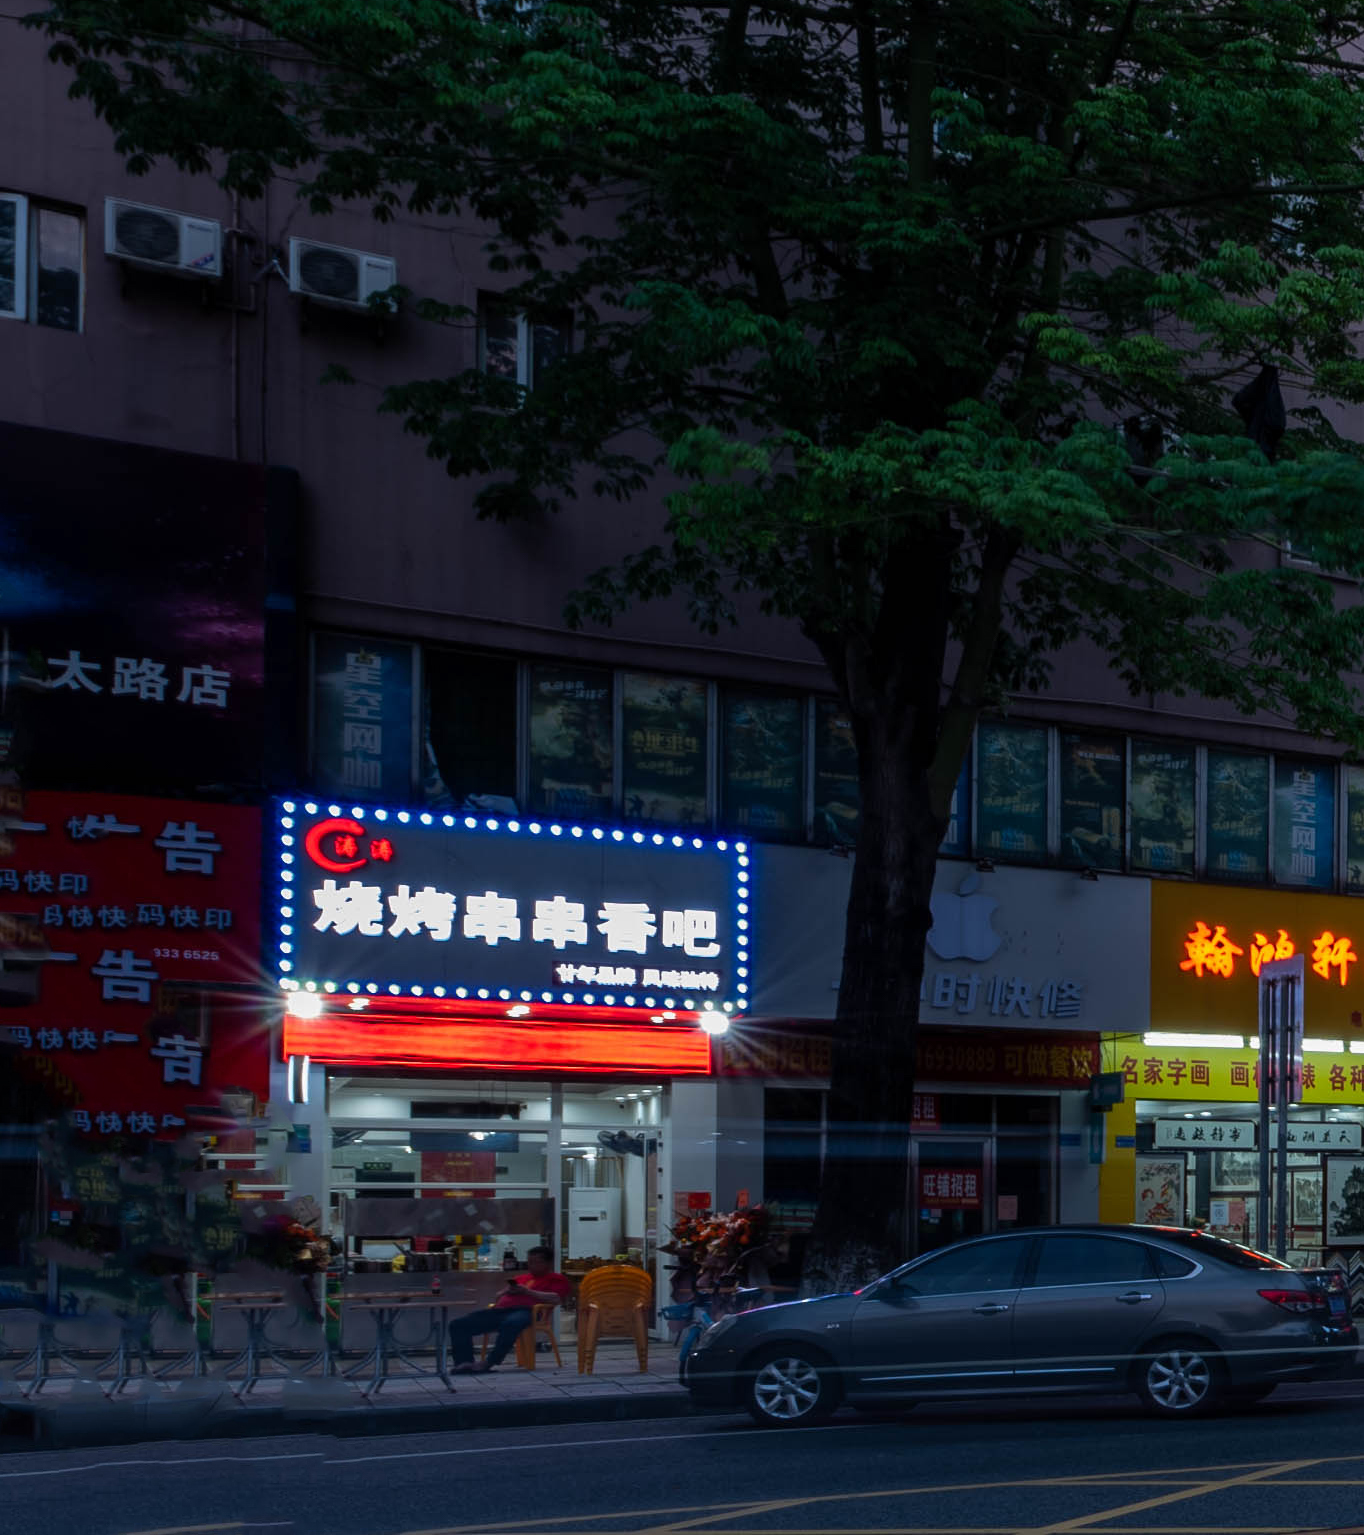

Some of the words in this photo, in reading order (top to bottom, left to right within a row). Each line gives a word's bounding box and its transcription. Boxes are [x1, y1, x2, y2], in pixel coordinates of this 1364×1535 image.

[344, 651, 382, 790] 星空网咖
[1291, 768, 1316, 879] 星空网咖
[313, 879, 721, 958] 烧烤串串香吧
[1121, 1056, 1211, 1087] 名家字画
[1230, 1062, 1317, 1090] 画裱
